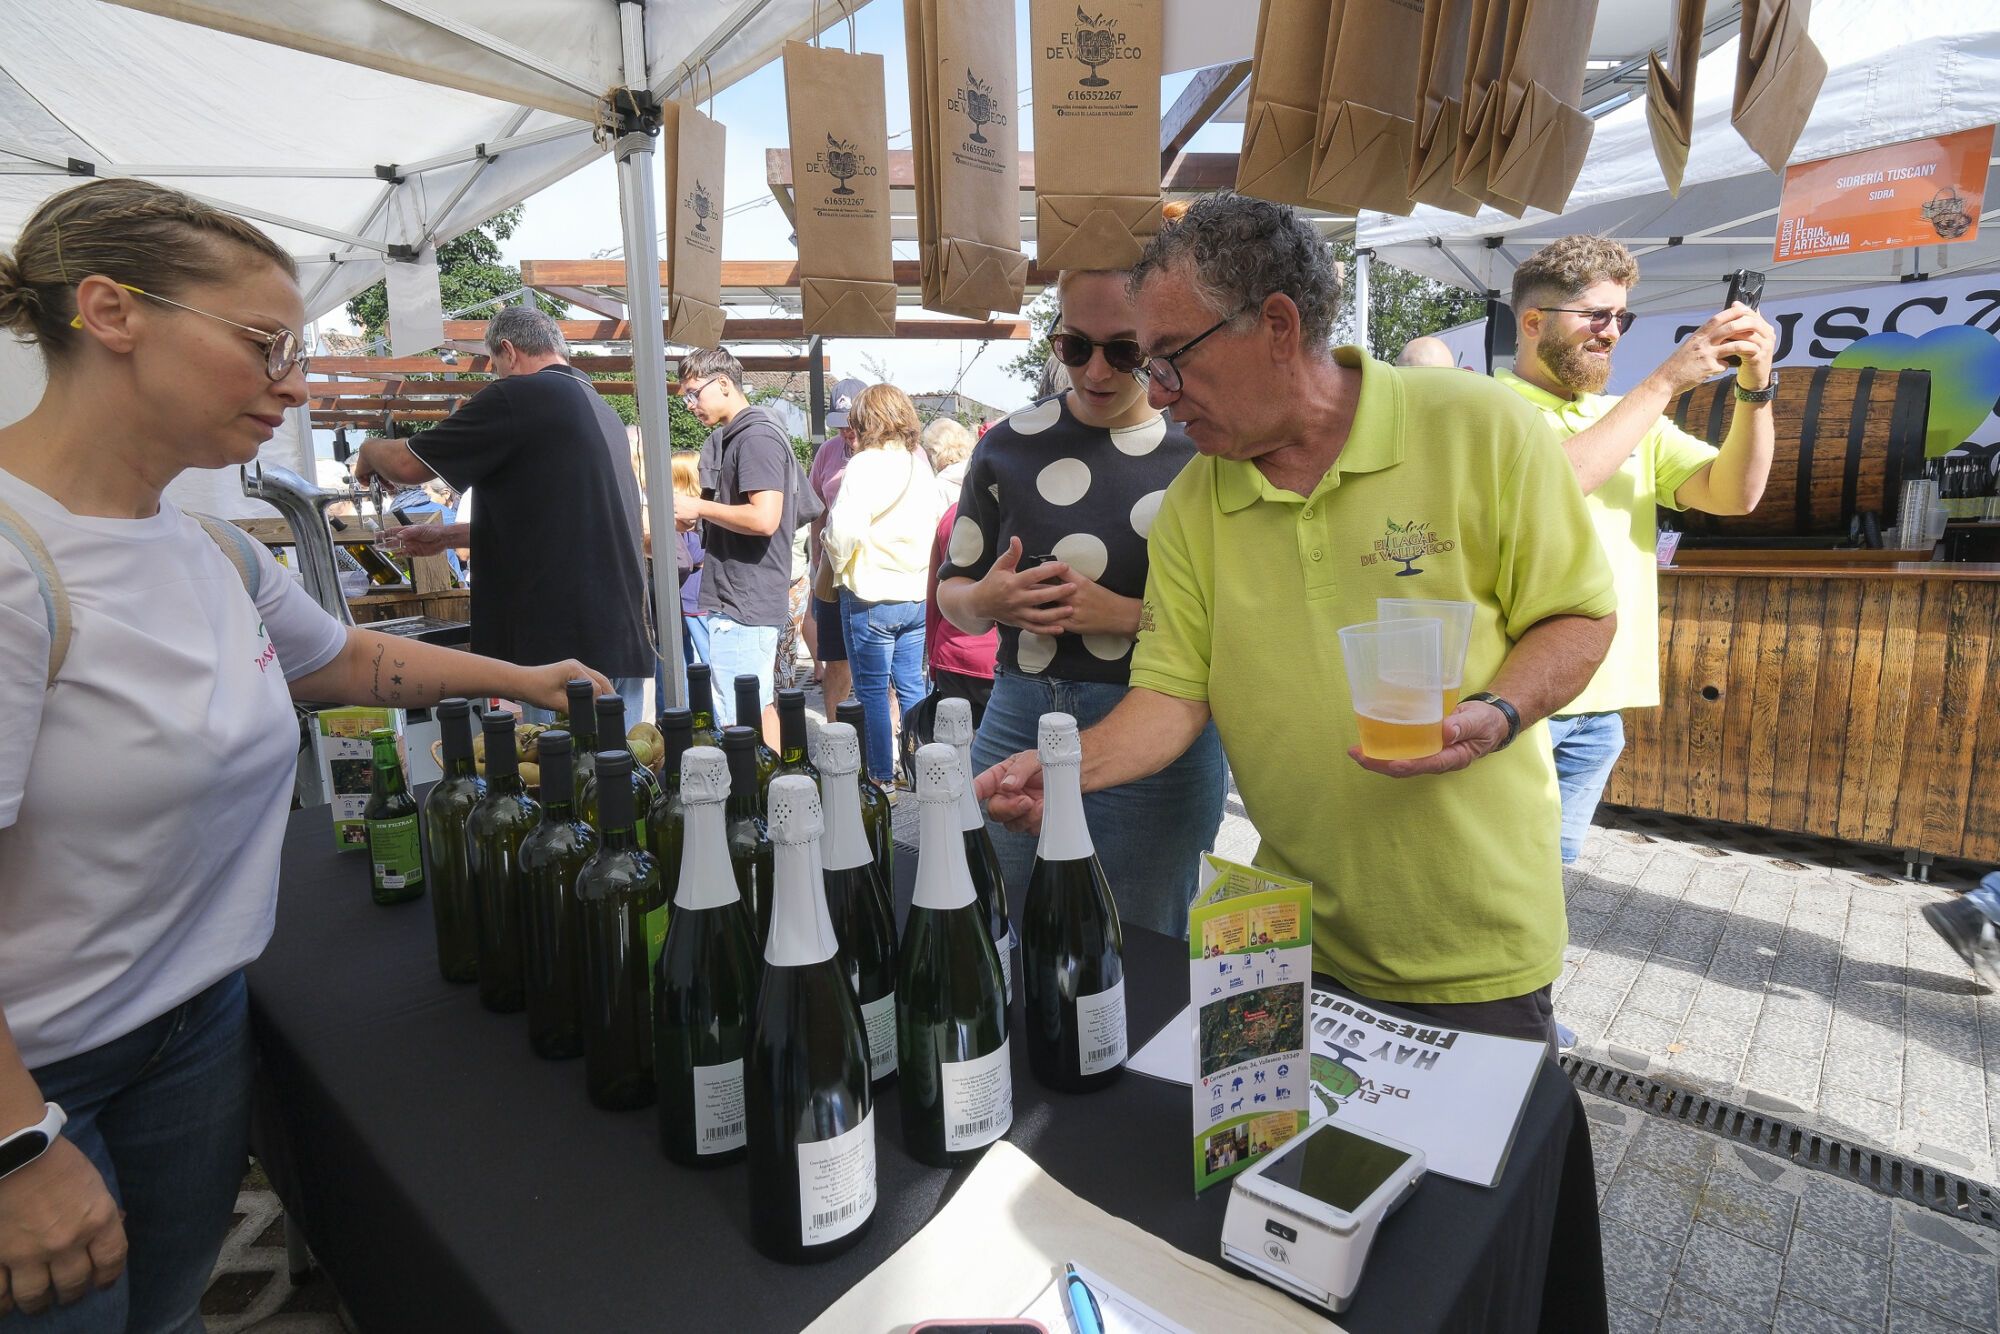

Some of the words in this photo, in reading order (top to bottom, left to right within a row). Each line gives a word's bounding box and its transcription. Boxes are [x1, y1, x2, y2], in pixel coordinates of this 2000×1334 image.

[1061, 33, 1075, 45] EL
[1046, 47, 1065, 59] DE
[1067, 90, 1122, 101] 616552267
[947, 99, 960, 112] DE
[962, 143, 996, 158] 616552267
[806, 163, 821, 173] DE
[1836, 171, 1883, 189] SIDRERÍA
[1887, 163, 1937, 183] TUSCANY
[824, 198, 865, 206] 616552267
[1868, 189, 1895, 201] SIDRA
[1779, 219, 1794, 257] VALLESECO
[1795, 226, 1825, 241] FERIA
[1793, 232, 1850, 251] ARTESANÍA
[1391, 532, 1439, 549] LAGAR
[1360, 552, 1378, 567] DE
[1379, 540, 1456, 562] VALLESECO
[1369, 1041, 1440, 1071] HAY
[1380, 1083, 1411, 1100] DE
